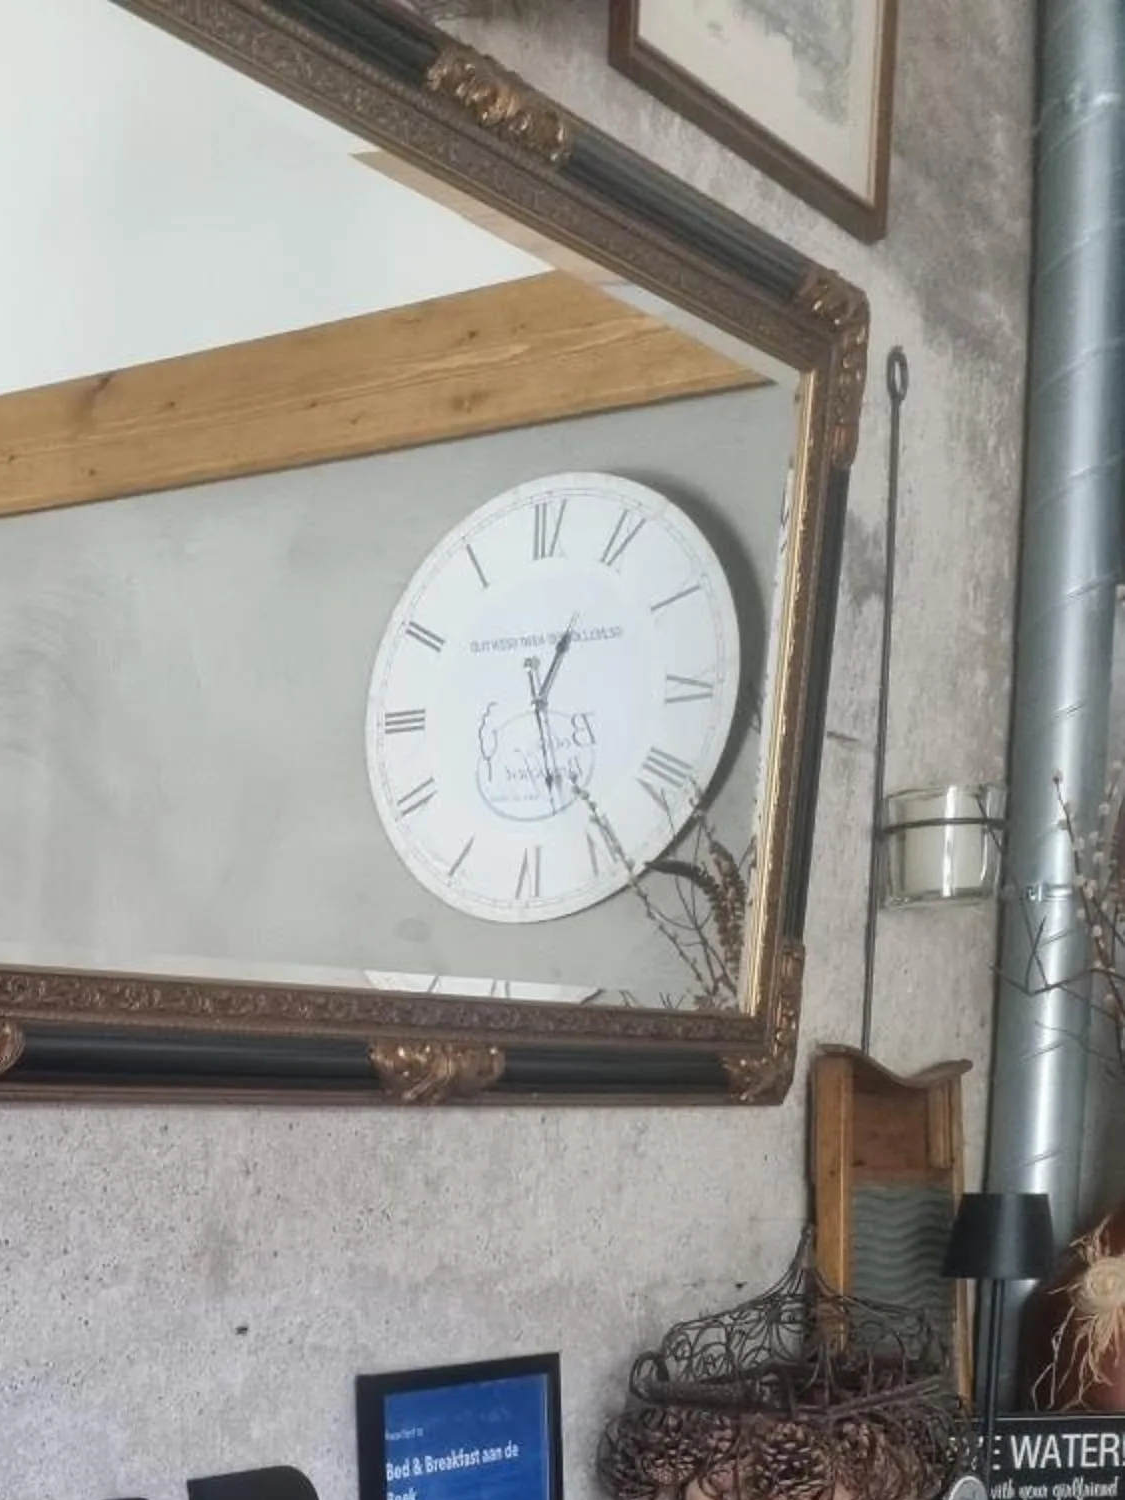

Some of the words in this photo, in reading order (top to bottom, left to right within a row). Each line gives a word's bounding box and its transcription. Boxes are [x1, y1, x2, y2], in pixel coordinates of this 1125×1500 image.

[385, 1458, 410, 1482] Bed
[424, 1448, 480, 1474] Breakfast
[482, 1447, 502, 1462] aan
[504, 1440, 520, 1459] de
